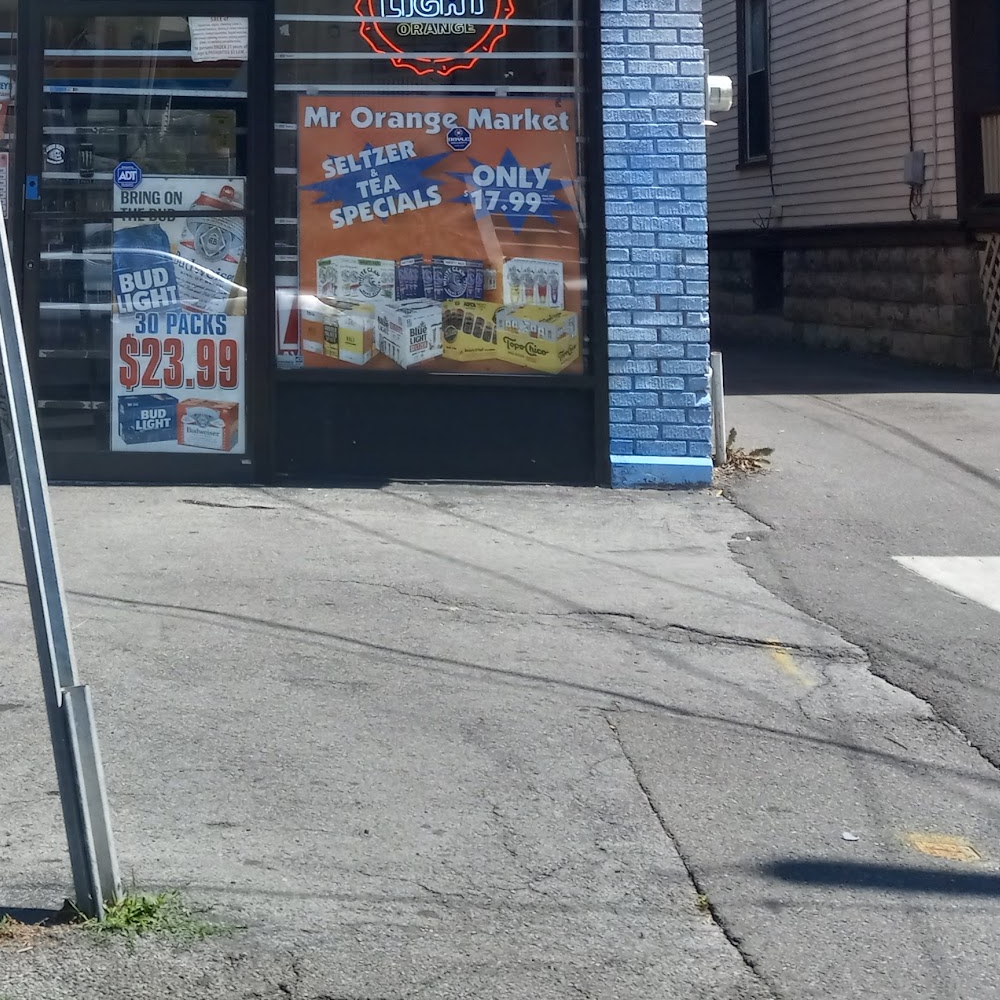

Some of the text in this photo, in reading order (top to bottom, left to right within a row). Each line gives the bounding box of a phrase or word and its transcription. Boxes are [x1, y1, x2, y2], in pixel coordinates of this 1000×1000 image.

[396, 22, 476, 36] ORANGE
[304, 106, 570, 135] Mr Orange Market
[322, 140, 417, 179] SELTZER
[118, 170, 137, 181] ADT
[370, 168, 379, 177] &
[472, 165, 551, 190] ONLY
[120, 190, 183, 205] BRING ON
[356, 174, 401, 199] TEA
[329, 184, 442, 230] SPECIALS
[118, 267, 169, 294] BUD
[117, 285, 178, 314] LIGHT
[135, 312, 227, 335] 30 PACKS
[410, 326, 427, 337] Blue
[410, 334, 428, 344] LIGHT
[503, 336, 526, 350] Topo
[525, 341, 550, 357] Chico
[119, 333, 239, 392] $23.99
[136, 418, 171, 431] LIGHT
[141, 408, 167, 420] BUD
